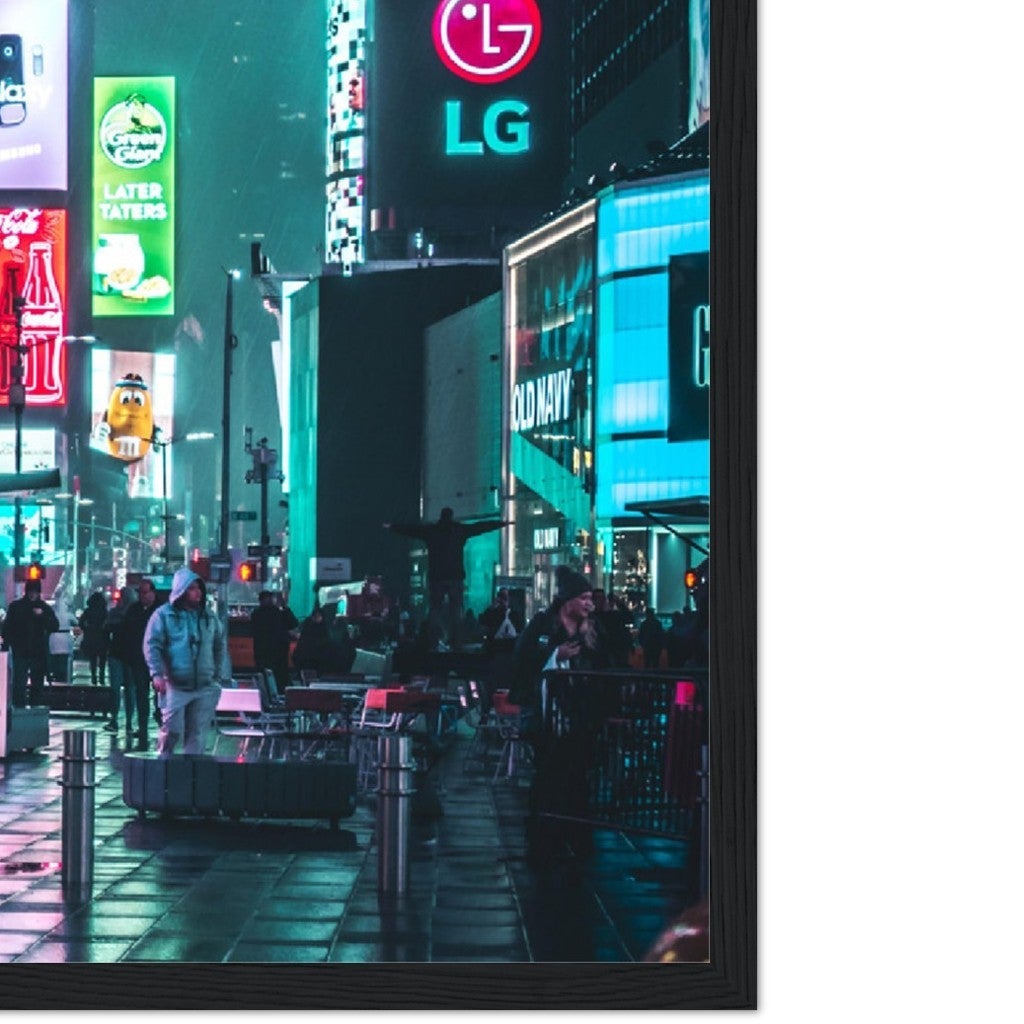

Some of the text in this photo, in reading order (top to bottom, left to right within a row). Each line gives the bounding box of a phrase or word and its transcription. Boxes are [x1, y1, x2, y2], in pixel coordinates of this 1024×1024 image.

[446, 101, 530, 155] LG
[103, 183, 162, 200] LATER
[100, 203, 167, 220] TATERS
[511, 367, 572, 432] OLD NAVY
